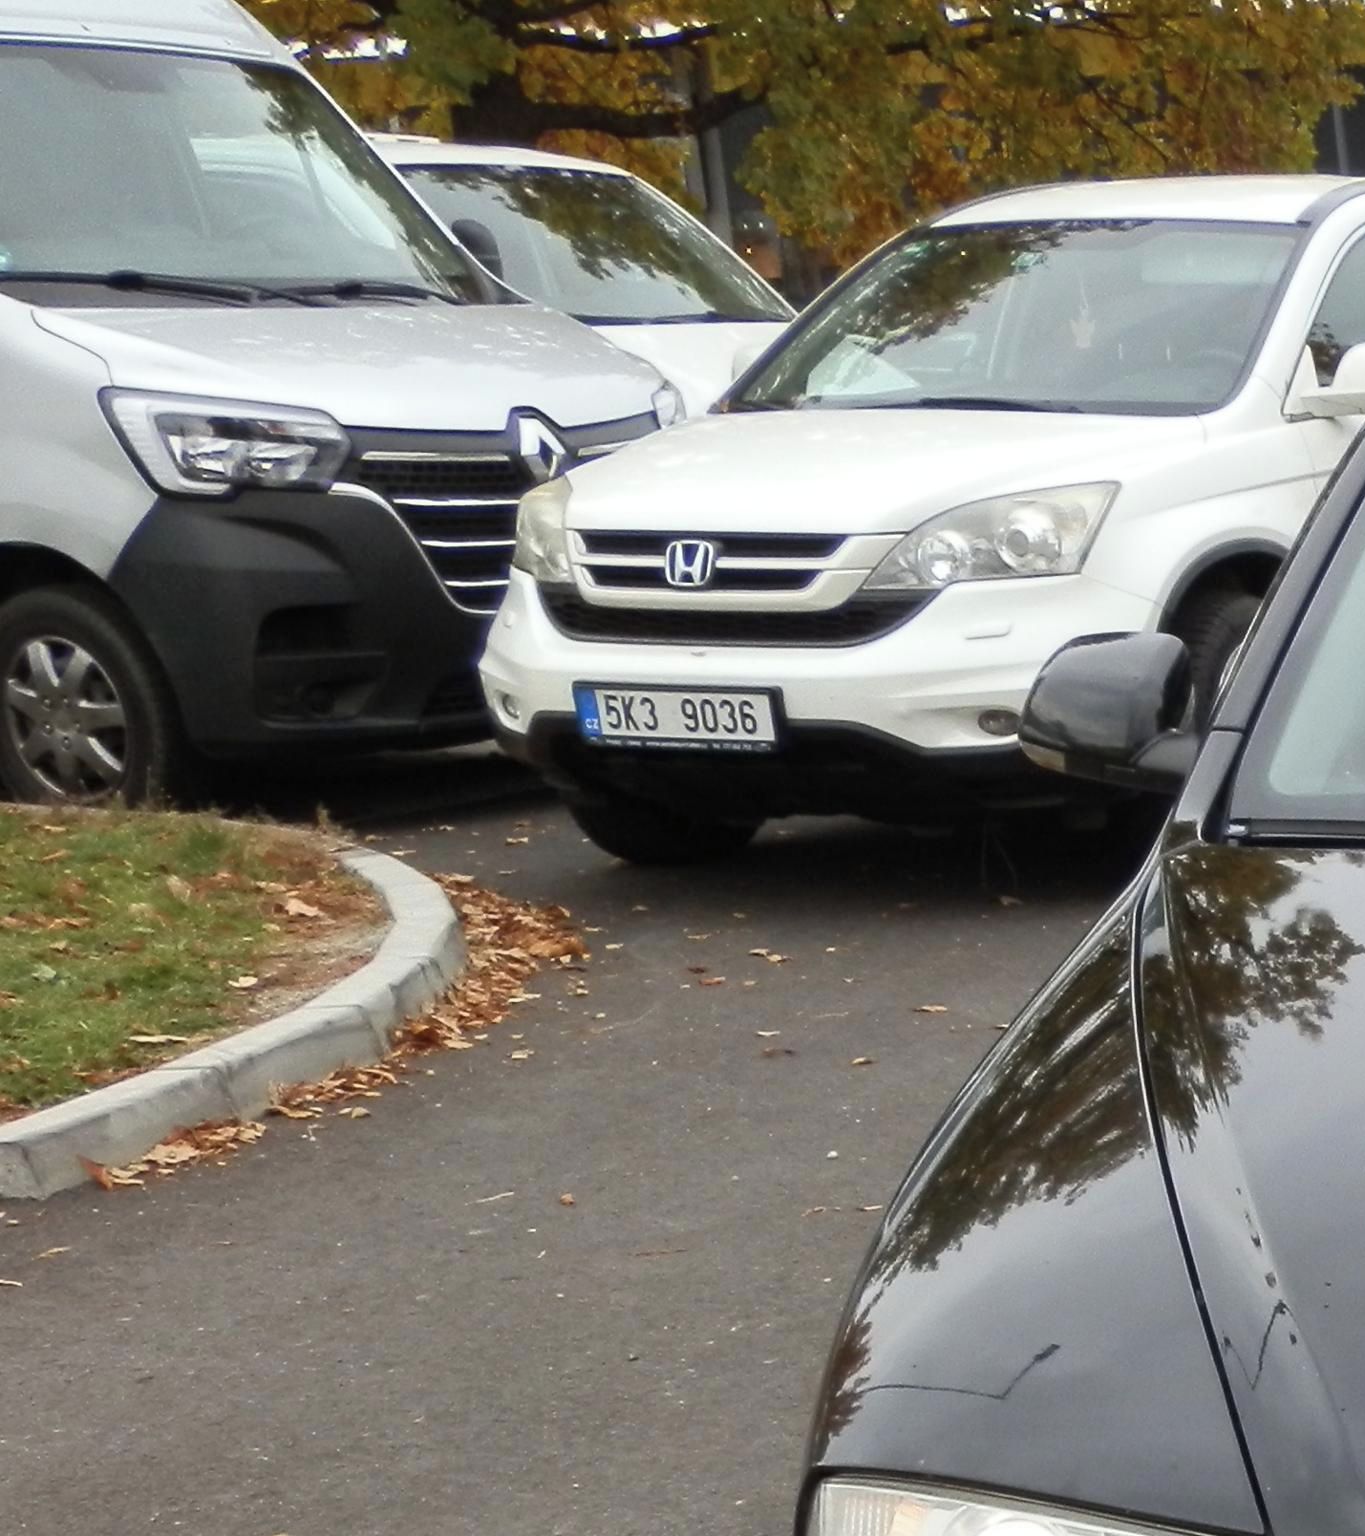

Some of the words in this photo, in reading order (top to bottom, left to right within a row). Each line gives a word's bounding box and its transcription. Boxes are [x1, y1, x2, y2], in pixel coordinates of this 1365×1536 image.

[585, 717, 599, 729] CZ
[603, 694, 658, 731] 5K3
[680, 698, 757, 734] 9036
